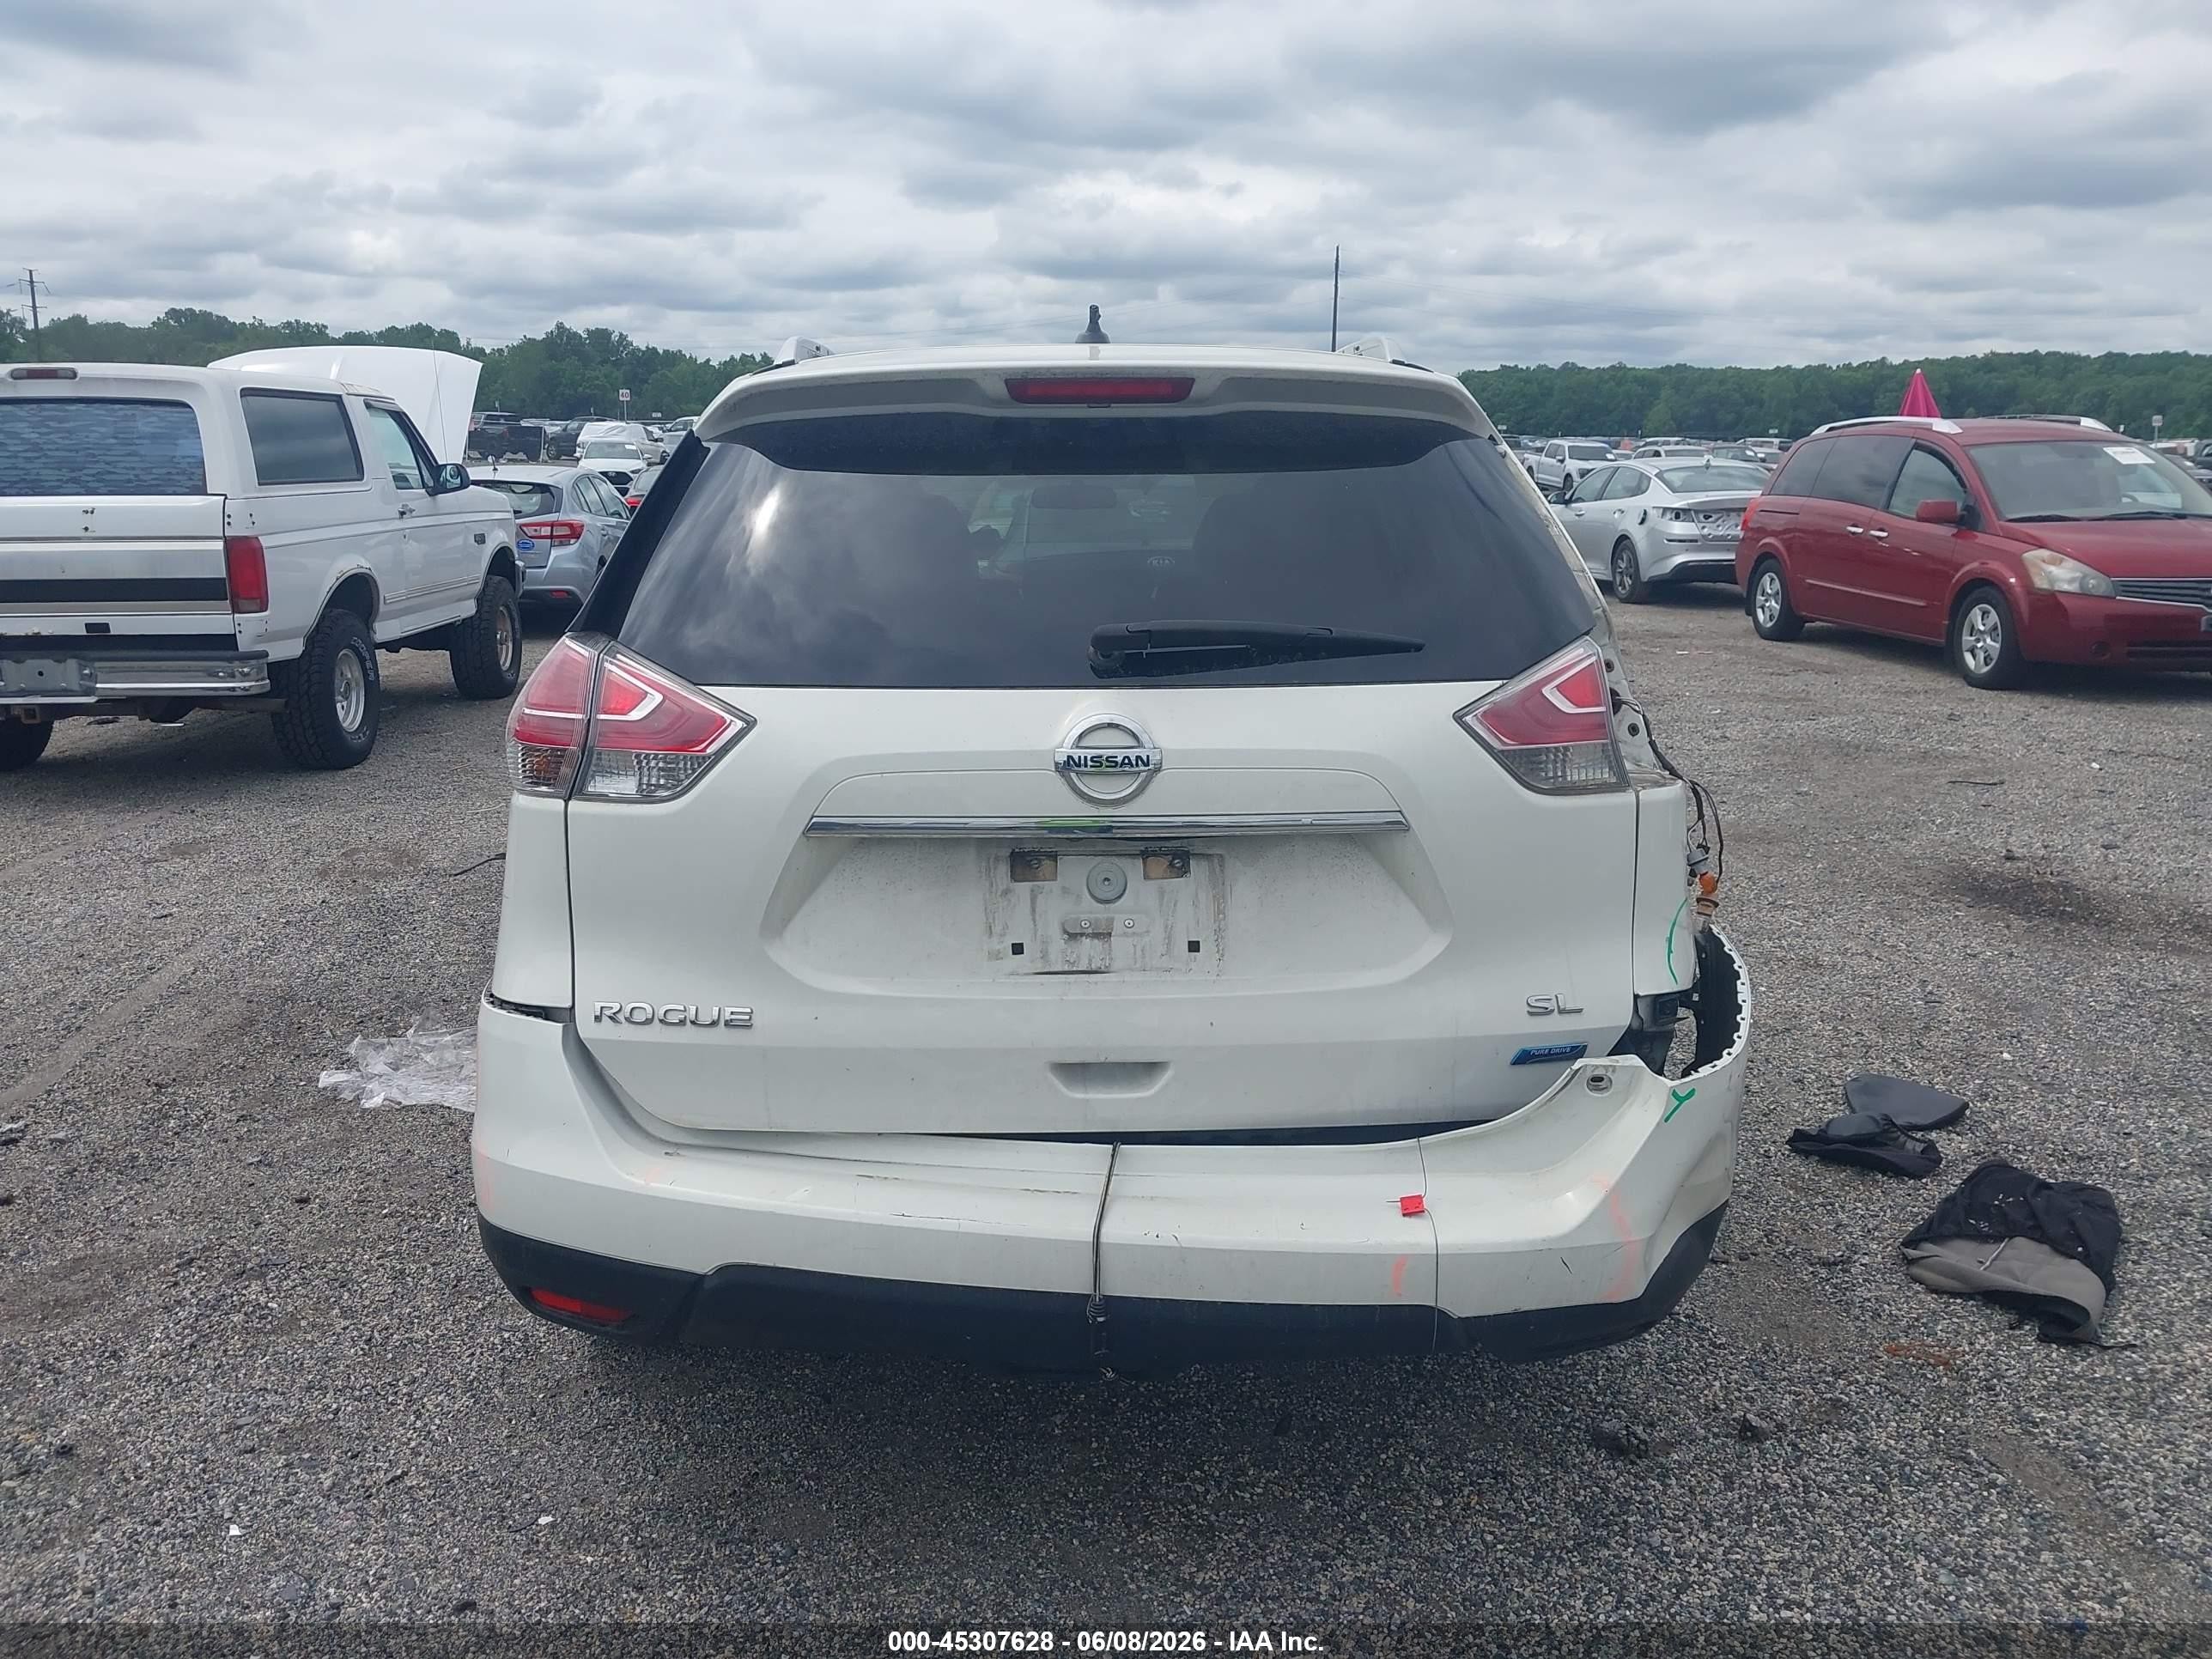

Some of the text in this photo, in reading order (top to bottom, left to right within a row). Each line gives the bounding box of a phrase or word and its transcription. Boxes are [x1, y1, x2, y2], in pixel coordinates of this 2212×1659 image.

[1065, 754, 1151, 769] NISSAN
[593, 1001, 754, 1029] ROGUE
[1526, 993, 1584, 1017] SL
